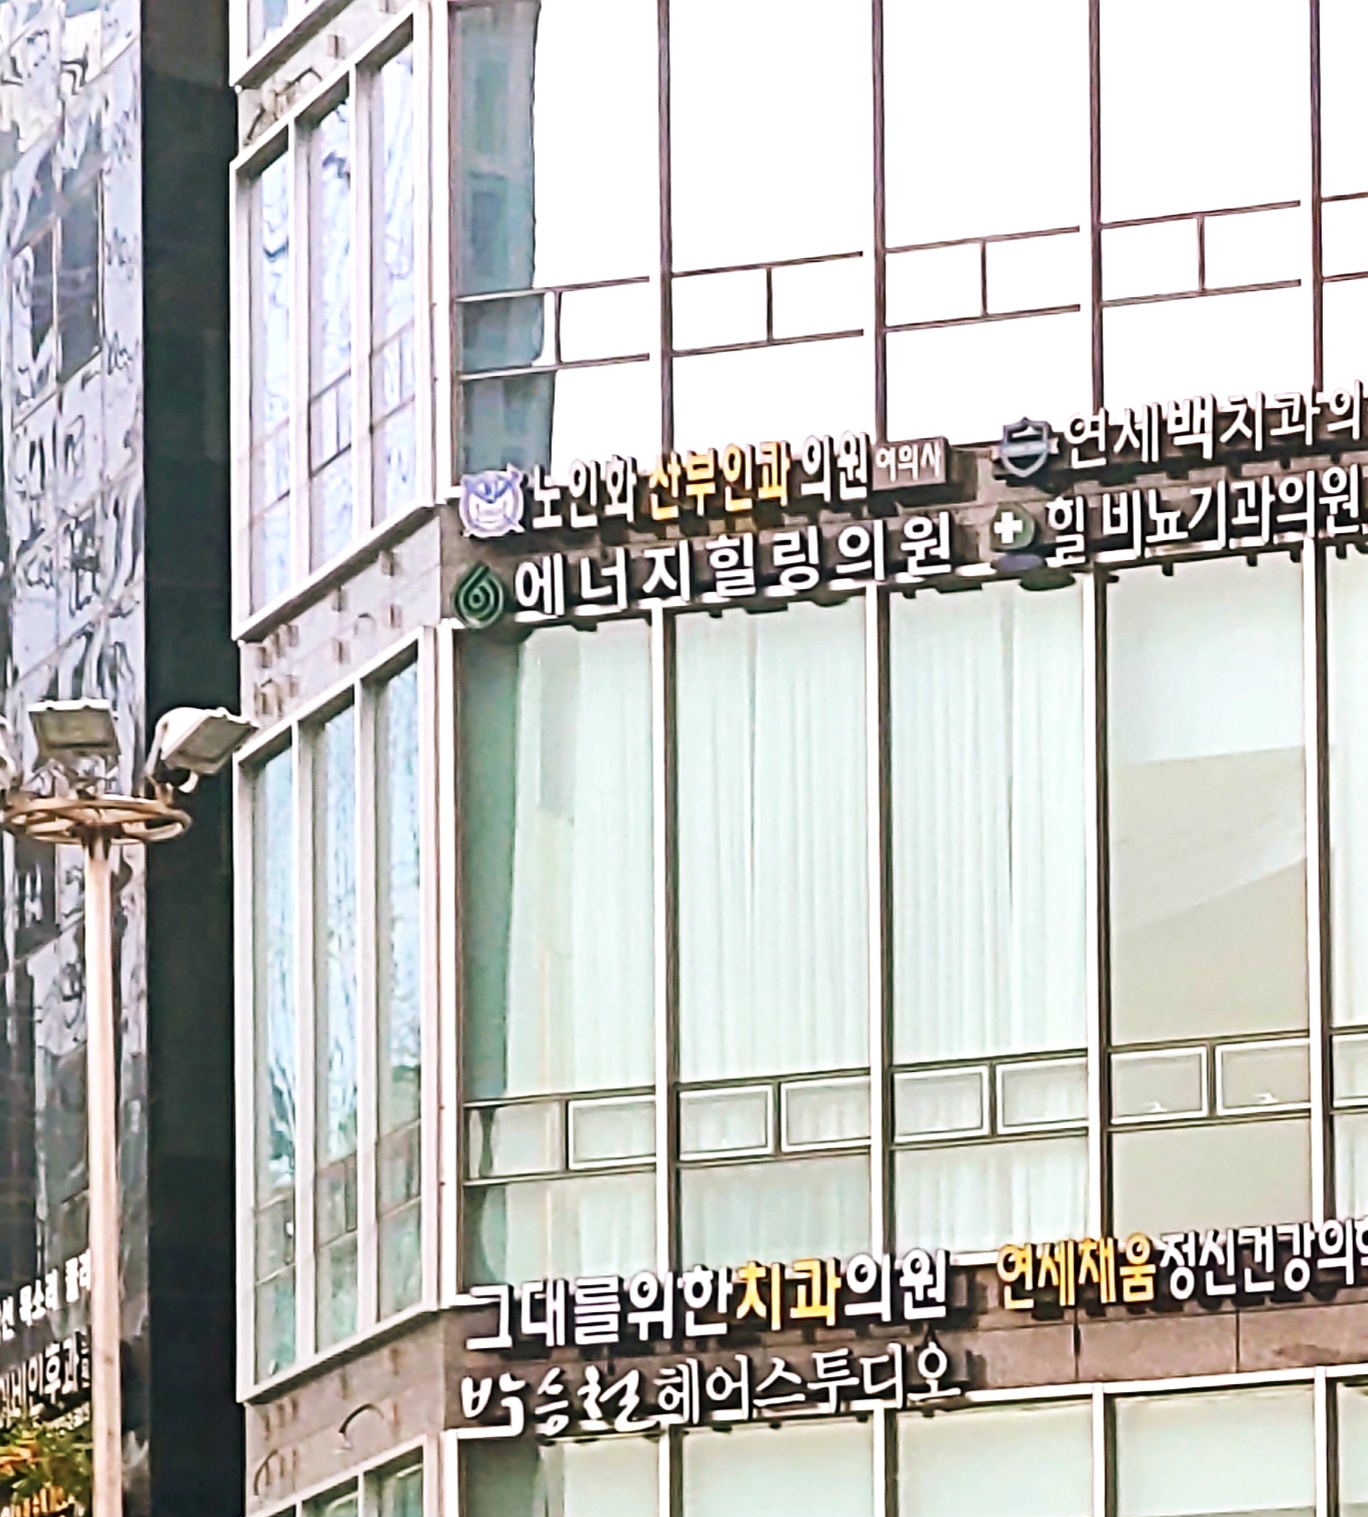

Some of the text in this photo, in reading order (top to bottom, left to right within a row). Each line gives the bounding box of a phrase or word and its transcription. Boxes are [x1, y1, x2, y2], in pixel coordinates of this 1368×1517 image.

[875, 441, 942, 482] 여의사
[515, 511, 952, 614] 에너지힐링의원
[466, 1247, 950, 1349] 그대를위한치과의원
